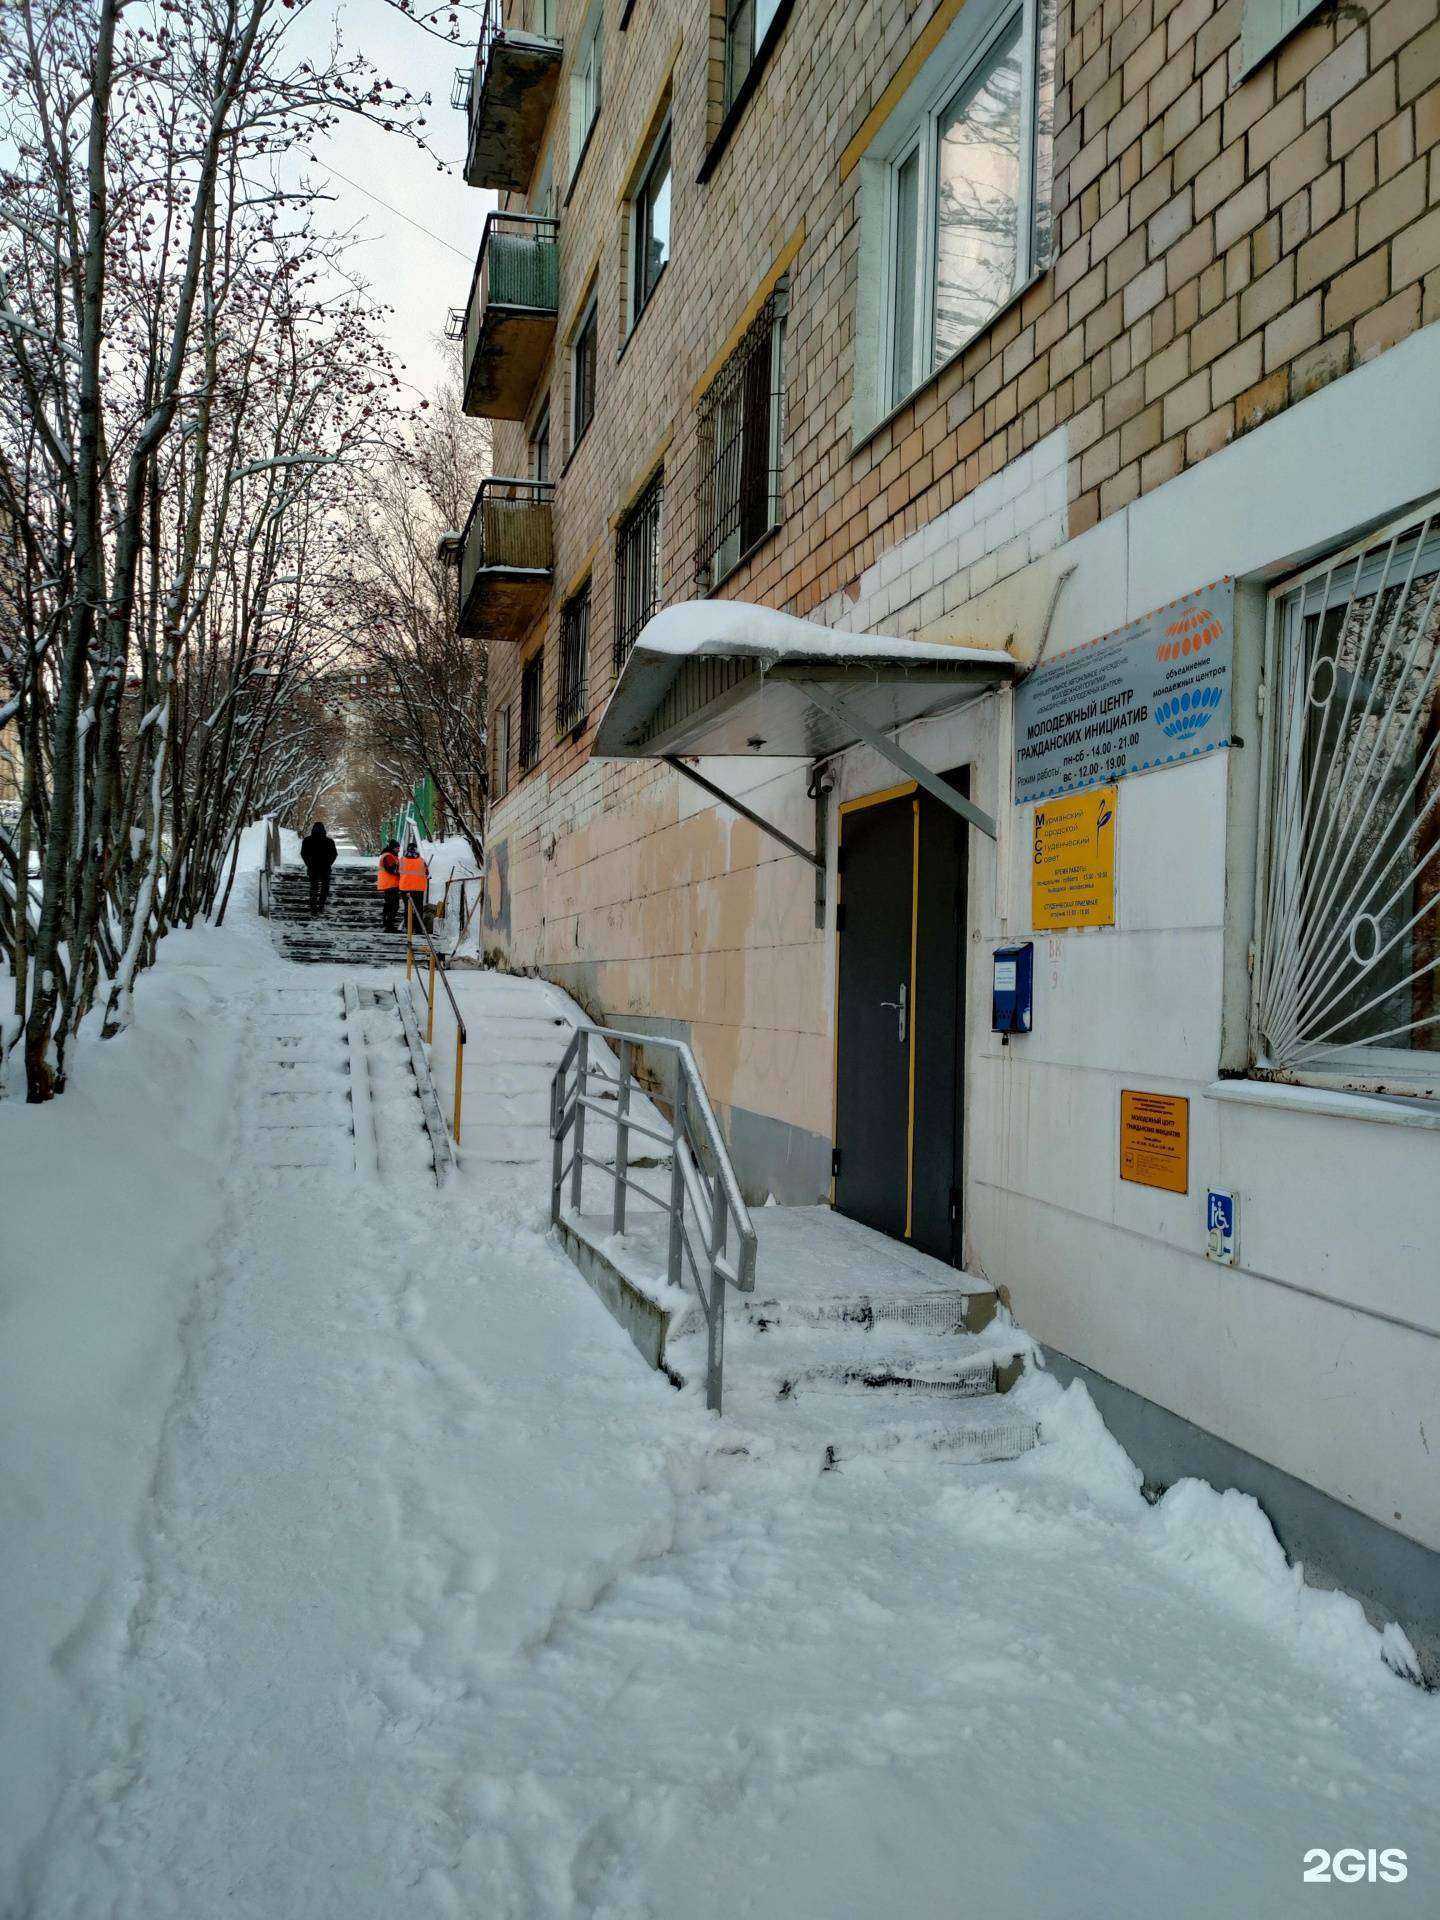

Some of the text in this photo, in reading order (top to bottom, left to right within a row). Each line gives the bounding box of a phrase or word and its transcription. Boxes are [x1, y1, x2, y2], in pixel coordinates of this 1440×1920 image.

[1152, 665, 1226, 699] молодежных центров
[1165, 656, 1211, 680] объединение
[1027, 689, 1134, 740] МОЛОДЕЖНЫЙ ЦЕНТР
[1017, 705, 1148, 762] ГРАЖДАНСКИХ ИНИЦИАТИВ
[1063, 750, 1085, 767] пн-сб
[1092, 742, 1112, 757] 14.00
[1118, 732, 1140, 750] 21.00
[1017, 773, 1036, 787] Режим
[1063, 772, 1073, 783] вс
[1079, 763, 1099, 778] 12.00
[1106, 754, 1126, 770] 19.00
